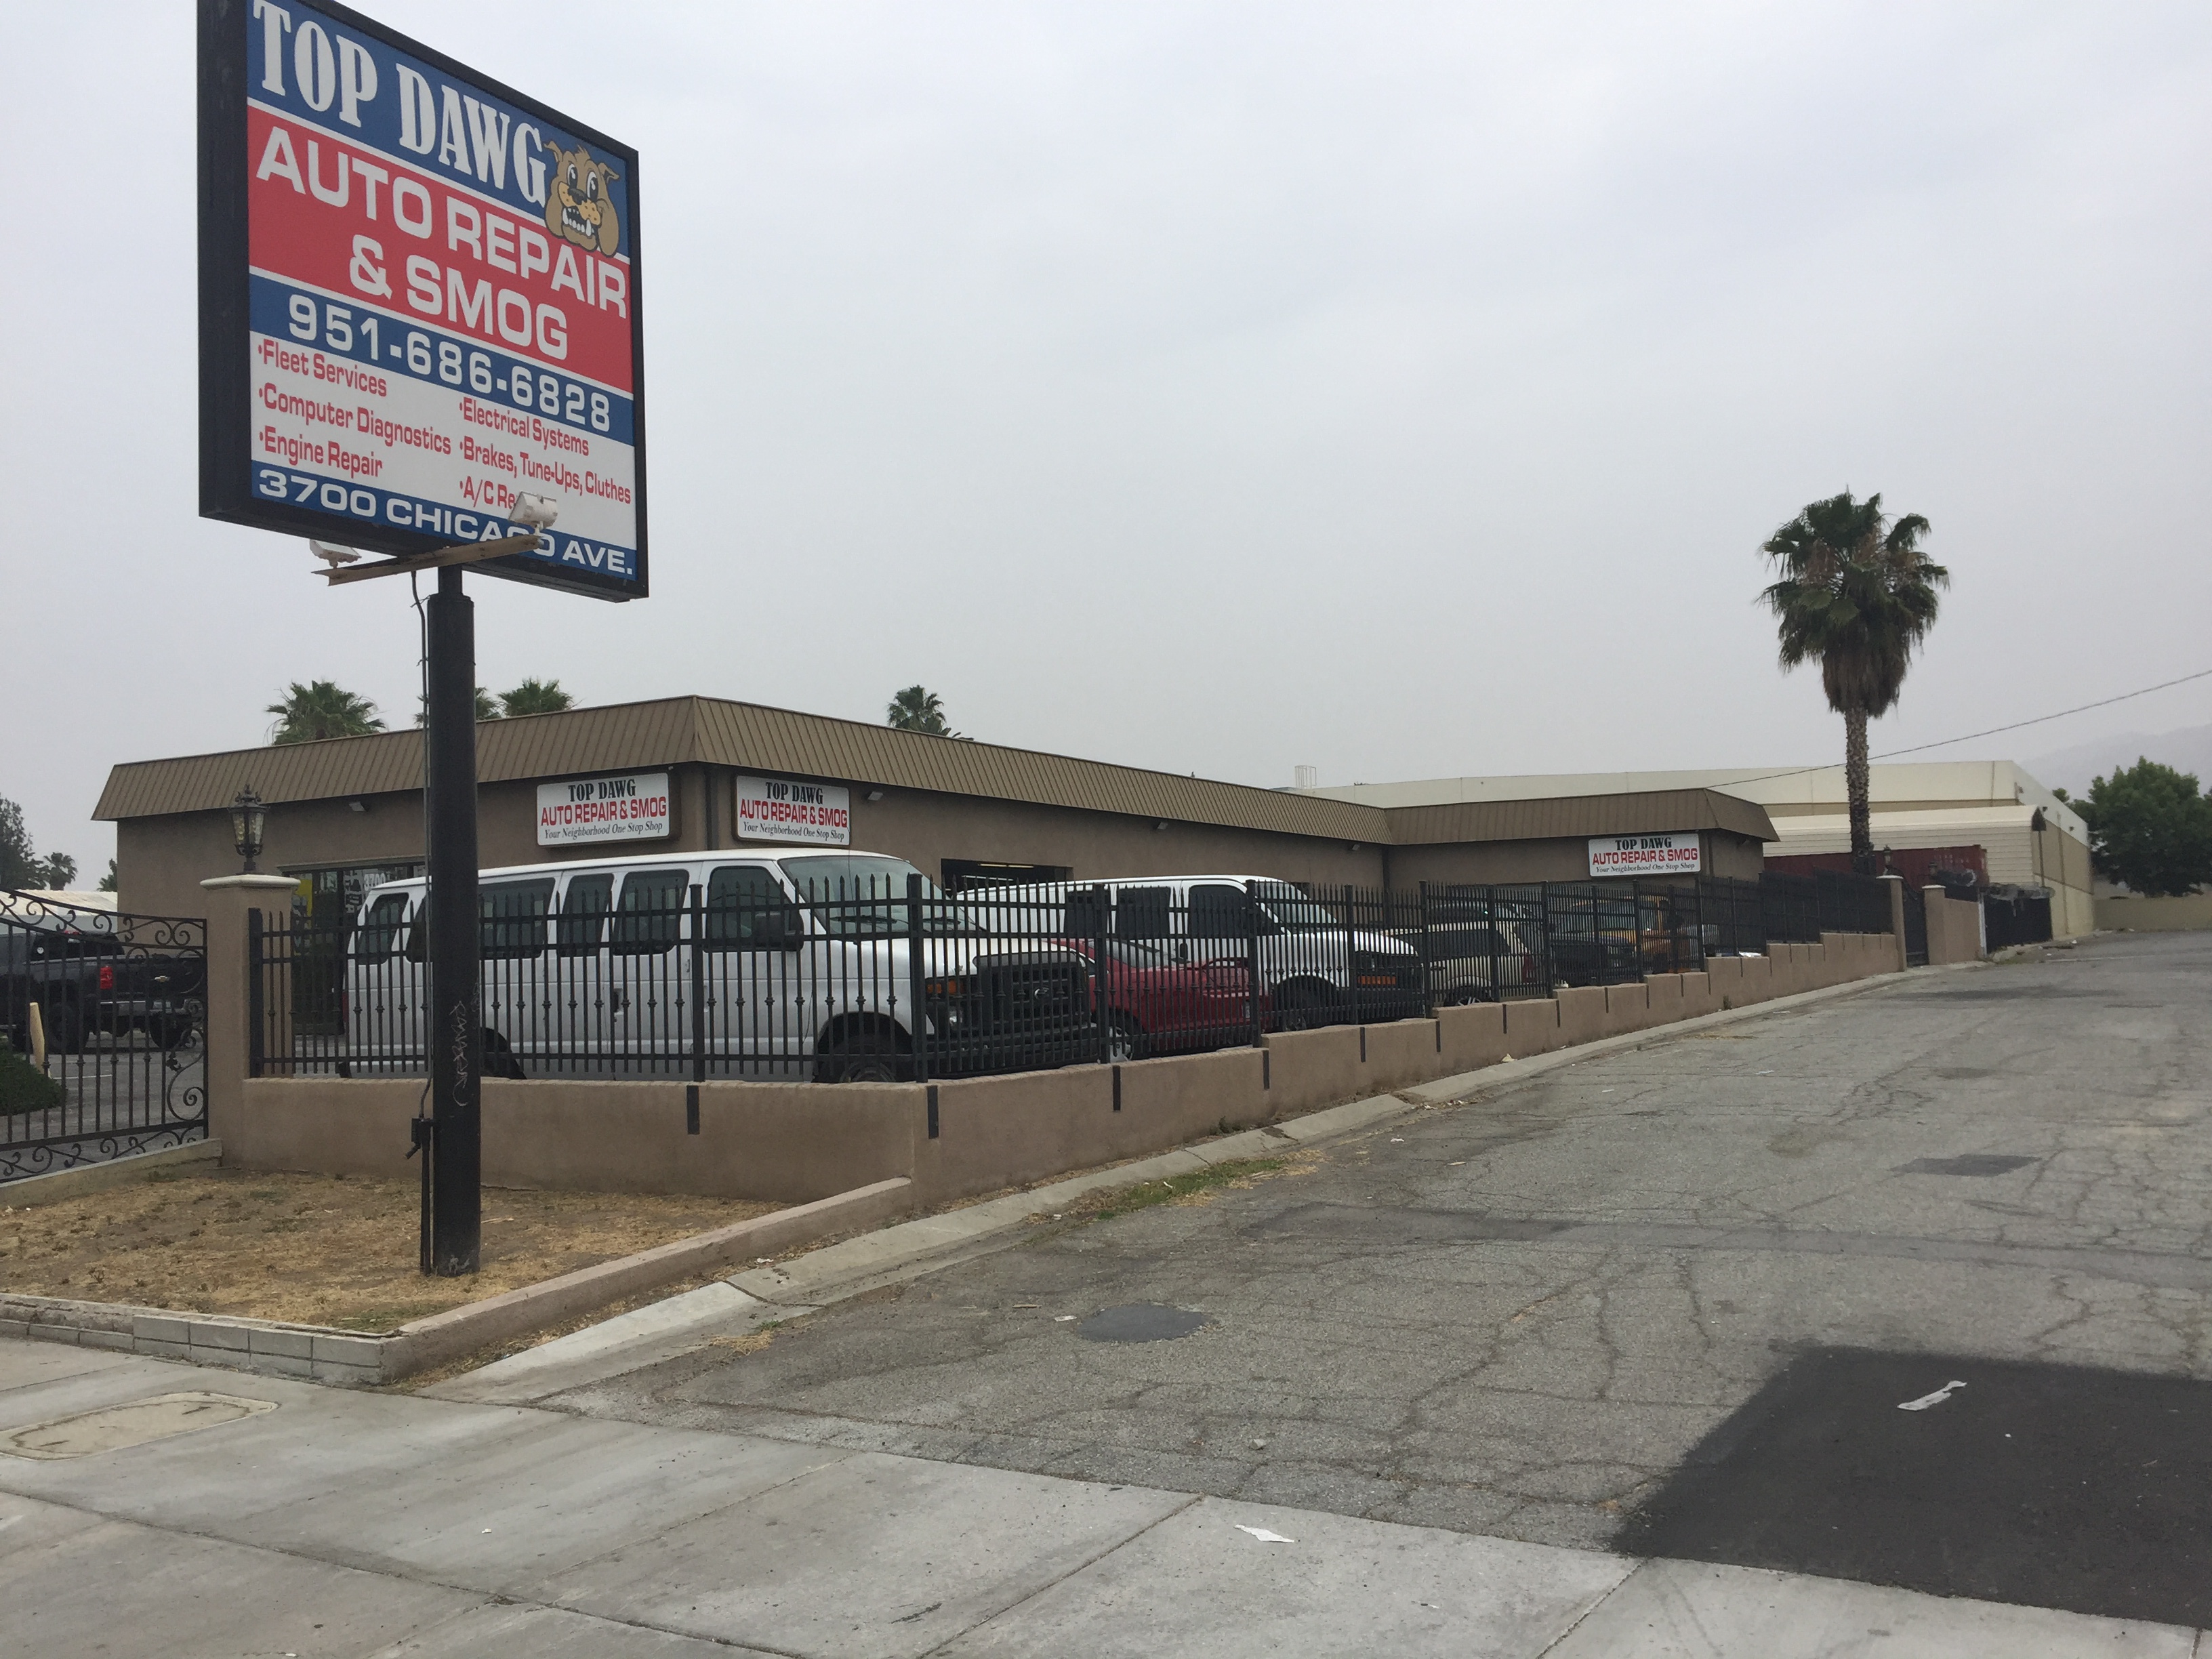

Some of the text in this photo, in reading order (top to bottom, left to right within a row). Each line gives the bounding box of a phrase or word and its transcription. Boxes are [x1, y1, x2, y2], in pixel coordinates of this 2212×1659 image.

[253, 0, 546, 208] TOP DAWG
[256, 126, 627, 319] AUTO REPAIR
[350, 234, 568, 360] & SMOG
[263, 339, 387, 397] Fleet Services
[289, 294, 610, 432] 951-686-6828
[264, 382, 451, 455] Computer Diagnostics
[464, 397, 589, 456] Electrical Systems
[264, 425, 383, 478] Engine Repair
[464, 436, 631, 504] Brakes, Tune-Ups, Cluthes
[463, 476, 494, 508] A/C
[259, 469, 376, 517] 3700
[562, 540, 633, 575] AVE.
[541, 796, 666, 826] AUTO REPAIR & SMOG
[568, 779, 636, 802] TOP DAWG
[766, 781, 823, 804] TOP DAWG
[544, 821, 663, 840] Your Neighborhood One Stop Shop
[740, 798, 847, 827] AUTO REPAIR & SMOG
[743, 821, 844, 842] Your Neighborhood One Stop Shop
[1593, 848, 1698, 865] AUTO REPAIR & SMOG
[1615, 837, 1672, 851] TOP DAWG
[1611, 864, 1651, 874] Neighborhood
[1665, 863, 1679, 871] Stop
[1680, 862, 1695, 870] Shop
